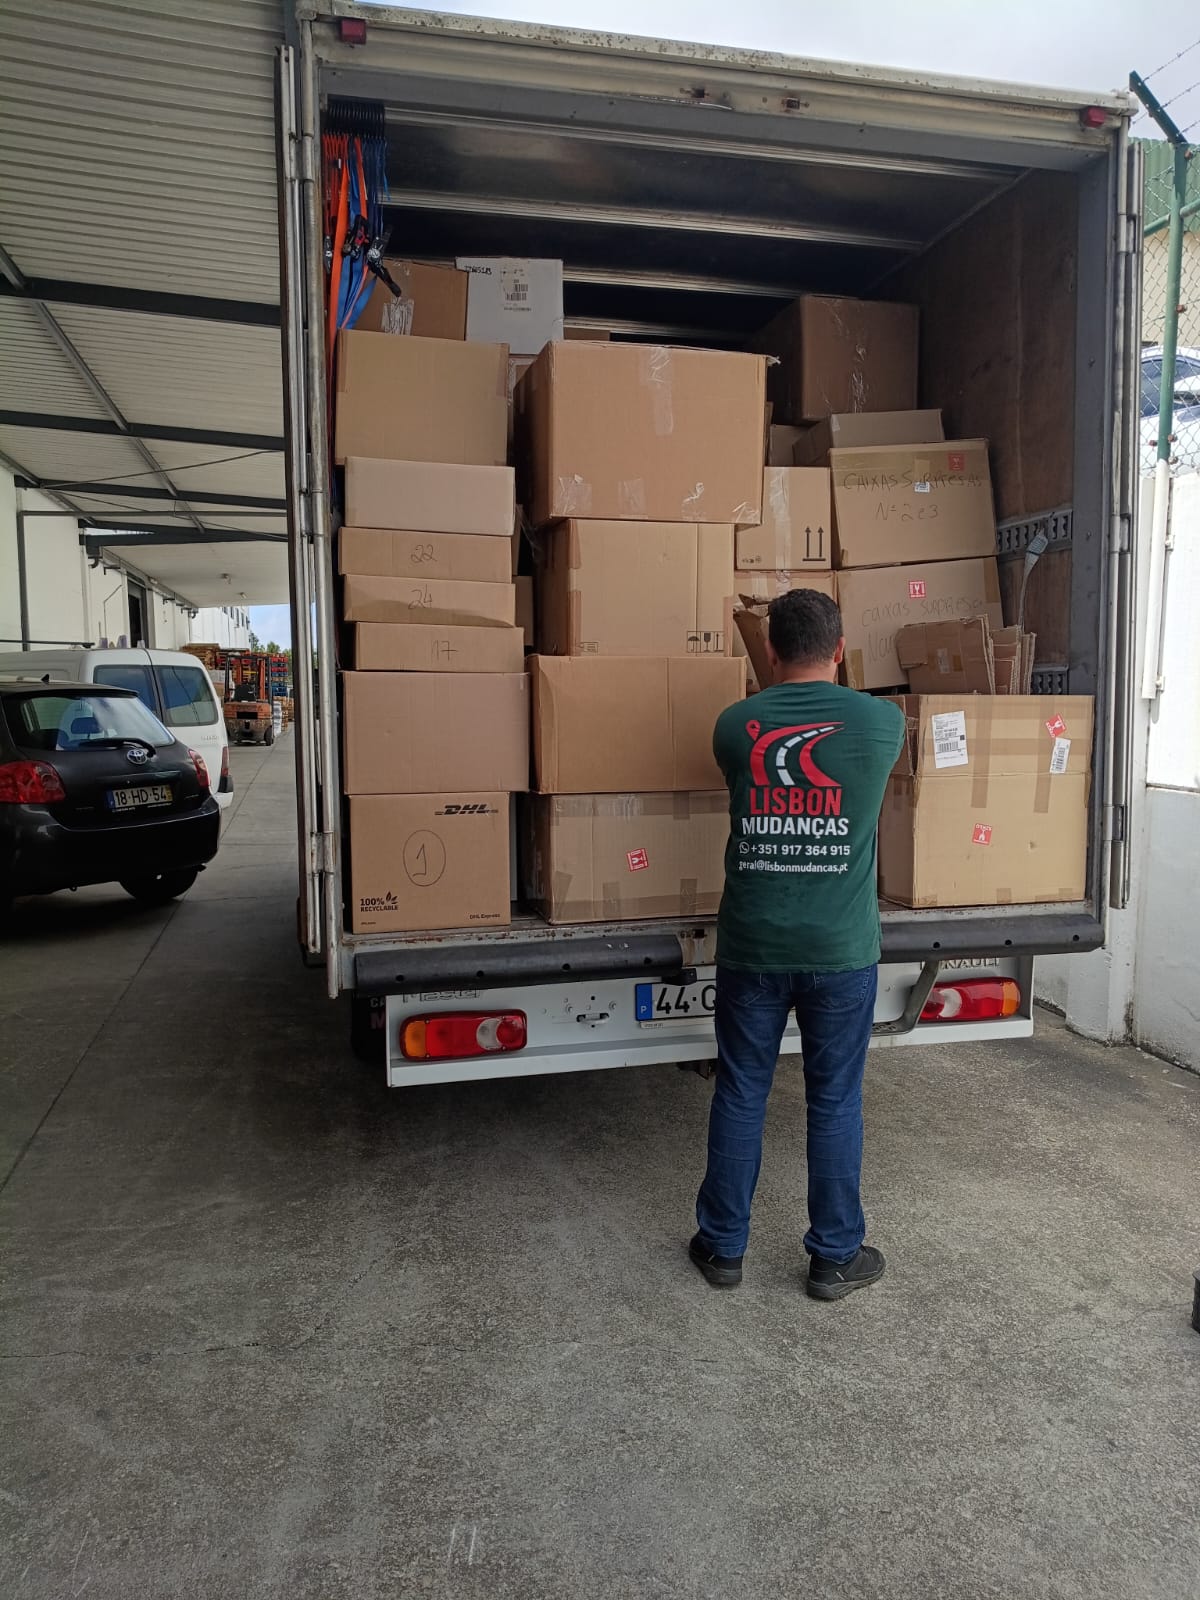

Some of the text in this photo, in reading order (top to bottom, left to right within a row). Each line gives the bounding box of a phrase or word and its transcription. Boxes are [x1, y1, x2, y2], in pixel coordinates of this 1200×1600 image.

[410, 543, 438, 563] 22
[407, 583, 433, 610] 24
[431, 640, 459, 661] 17
[443, 804, 491, 815] DHL
[750, 787, 842, 816] LISBON
[742, 816, 849, 839] MUDANÇAS
[751, 844, 851, 856] +351 917 364 915
[739, 860, 849, 874] geral@lisbonmudancas.pt
[360, 898, 385, 907] 100%
[360, 905, 399, 913] RECYCLABLE
